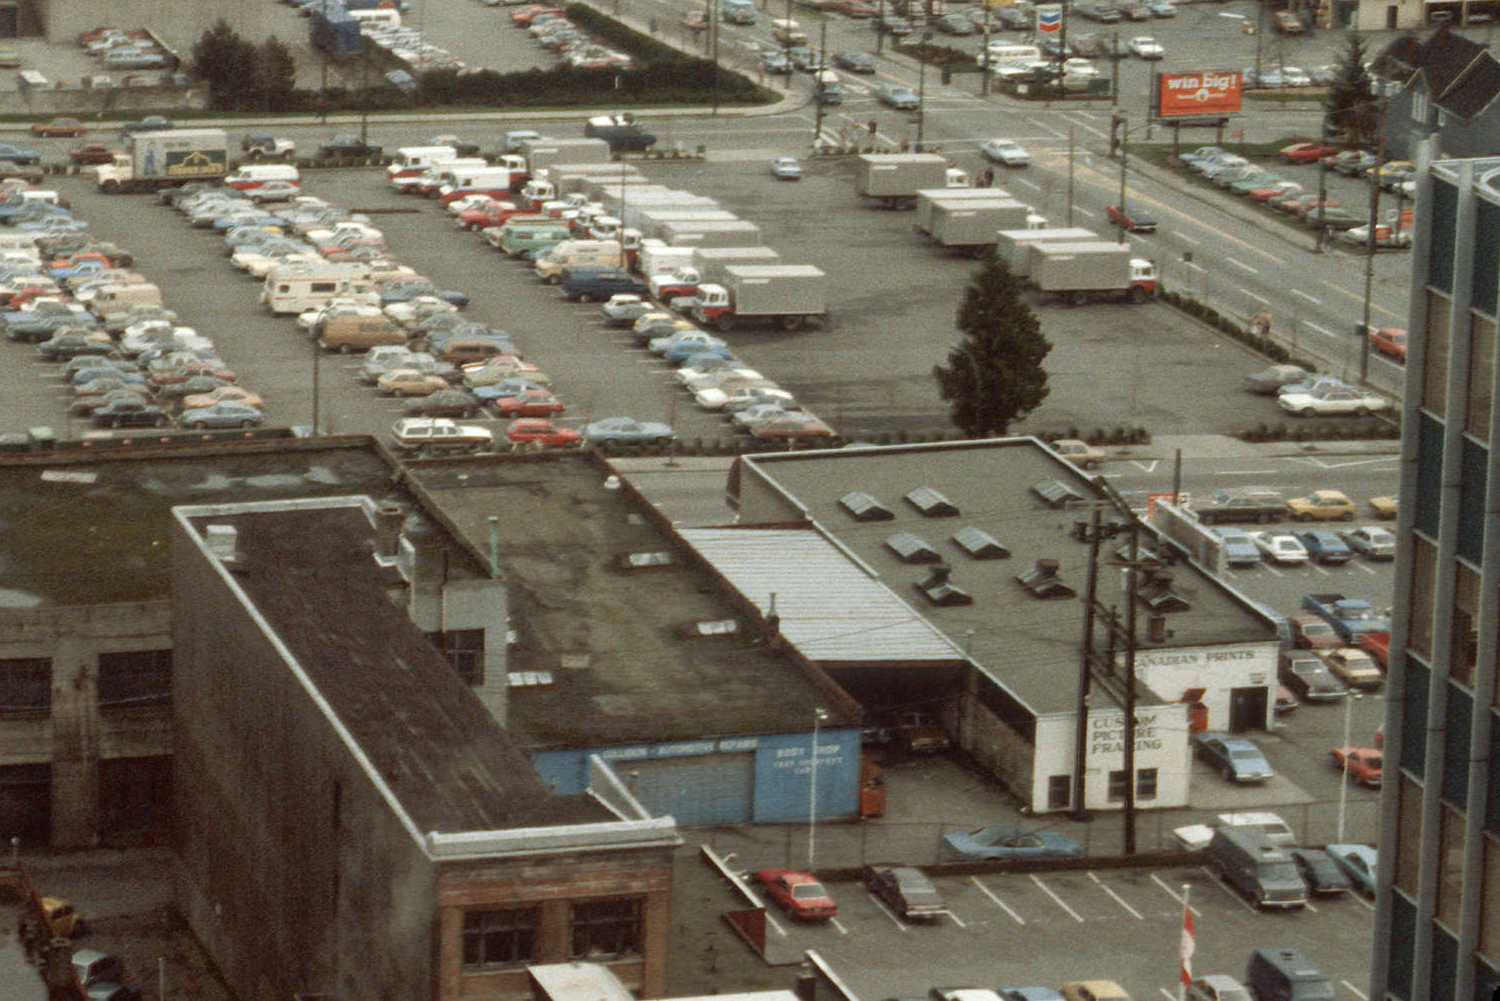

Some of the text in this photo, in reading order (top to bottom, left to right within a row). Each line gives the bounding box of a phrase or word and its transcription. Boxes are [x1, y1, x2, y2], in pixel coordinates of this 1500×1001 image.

[1168, 72, 1237, 91] win big!
[1205, 650, 1255, 662] PRINTS
[1093, 727, 1156, 741] PICTRE
[1091, 739, 1163, 754] FRAING
